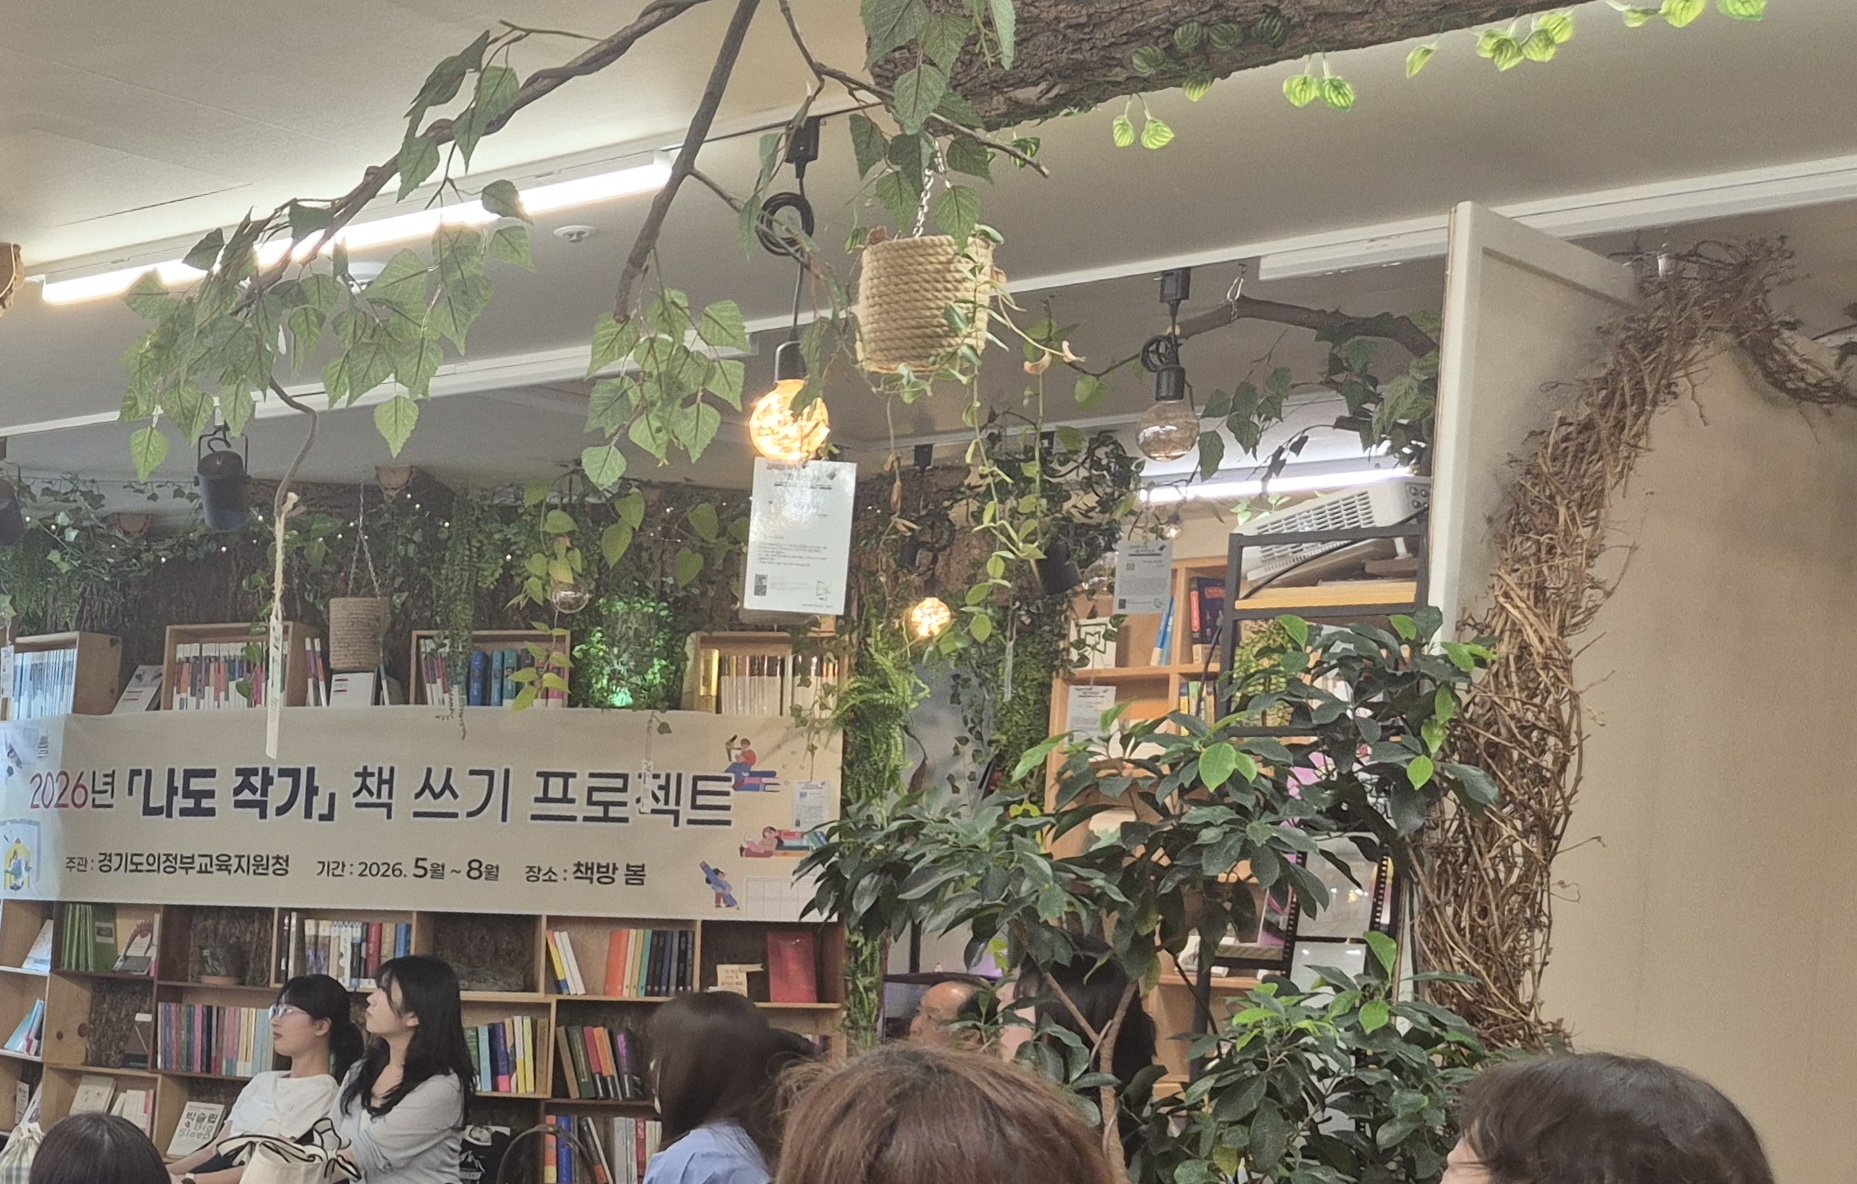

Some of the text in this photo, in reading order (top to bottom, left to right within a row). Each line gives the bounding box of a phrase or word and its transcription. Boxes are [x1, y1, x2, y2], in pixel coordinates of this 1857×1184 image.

[28, 769, 116, 811] 2026년
[351, 764, 396, 821] 책
[412, 765, 511, 823] 쓰기
[65, 855, 89, 873] 주관
[97, 852, 290, 877] 경기도의정부교육지원청
[316, 861, 346, 878] 기간
[357, 862, 408, 878] 2026.
[412, 857, 446, 880] 5월
[466, 858, 500, 881] 8월
[524, 864, 558, 884] 장소
[572, 860, 618, 886] 책방
[624, 861, 647, 887] 봄
